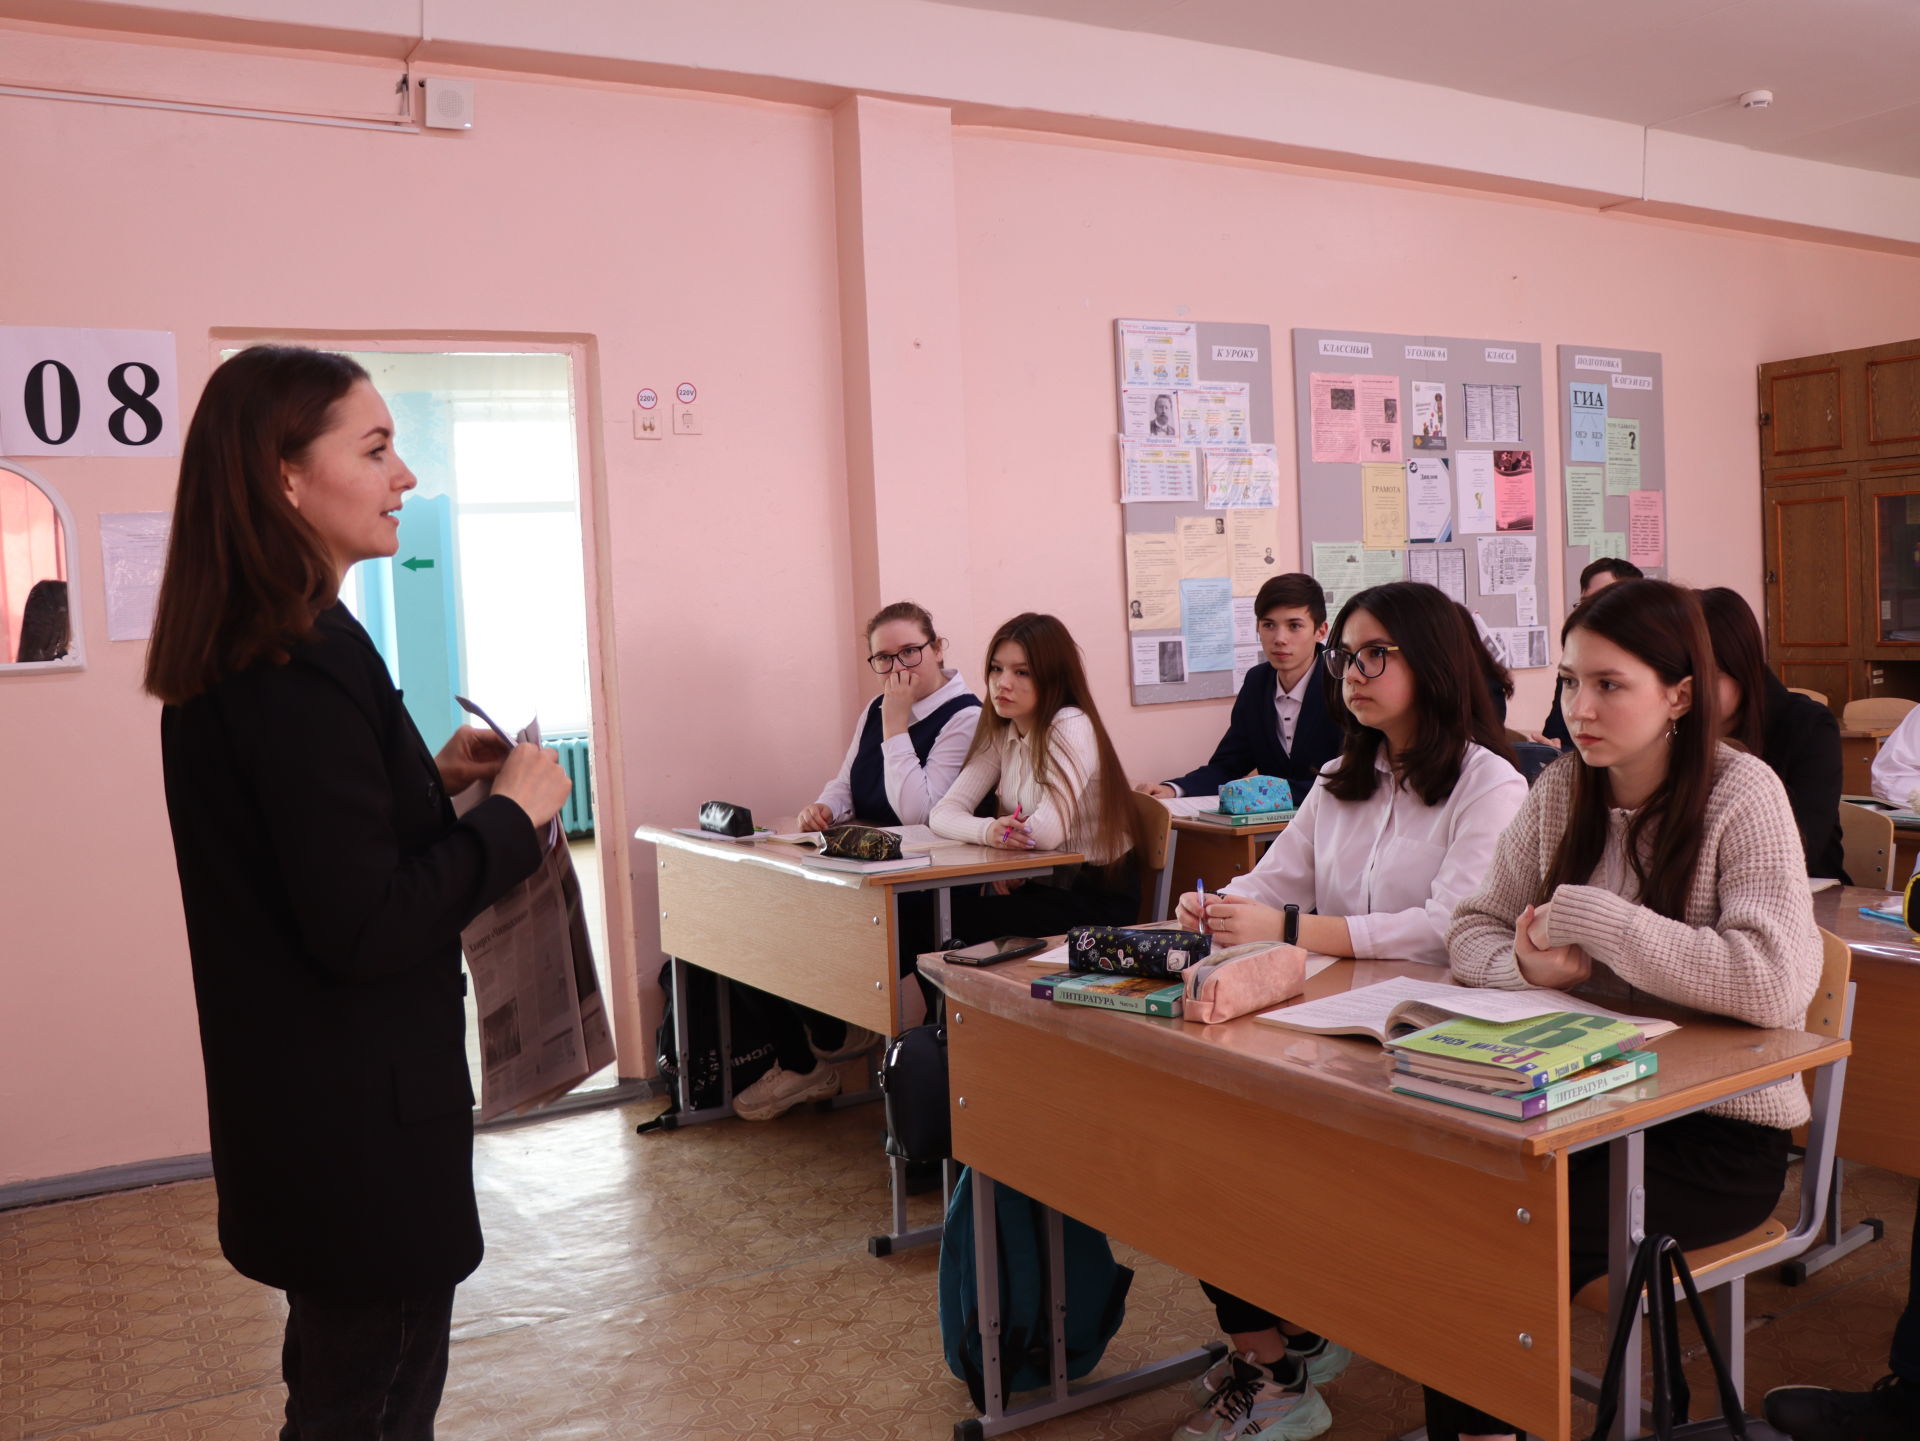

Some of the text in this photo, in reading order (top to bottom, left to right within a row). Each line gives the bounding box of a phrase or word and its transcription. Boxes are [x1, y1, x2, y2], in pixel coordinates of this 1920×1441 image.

[1217, 349, 1256, 358] К УРОКУ
[1322, 343, 1370, 355] КЛАССНЫЙ
[1573, 390, 1604, 407] ГИА
[1371, 485, 1401, 493] ГРАМОТА
[1060, 991, 1115, 1007] ЛИТЕРАТУРА
[1554, 1077, 1609, 1104] ЛИТЕРАТУРА
